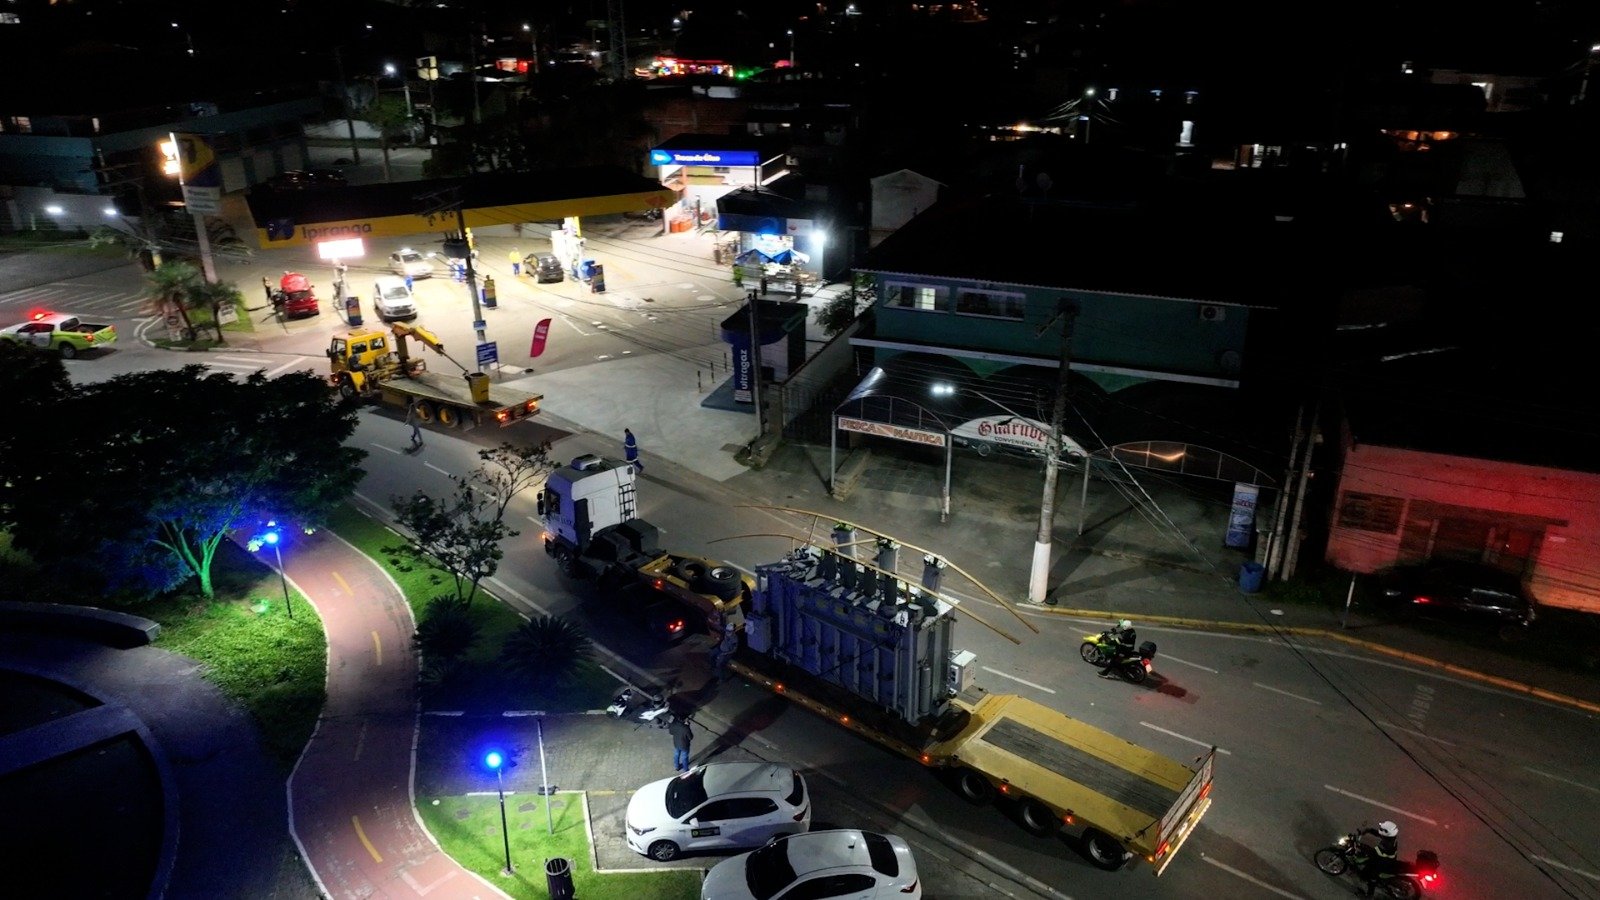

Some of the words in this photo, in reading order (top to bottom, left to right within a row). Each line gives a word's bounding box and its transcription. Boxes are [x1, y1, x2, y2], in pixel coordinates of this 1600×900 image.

[302, 223, 372, 241] Ipiranga
[740, 349, 750, 389] ultragaz
[840, 419, 876, 433] PESCA
[893, 428, 943, 446] NÁUTICA
[994, 436, 1040, 447] CONVENIÊNCIA
